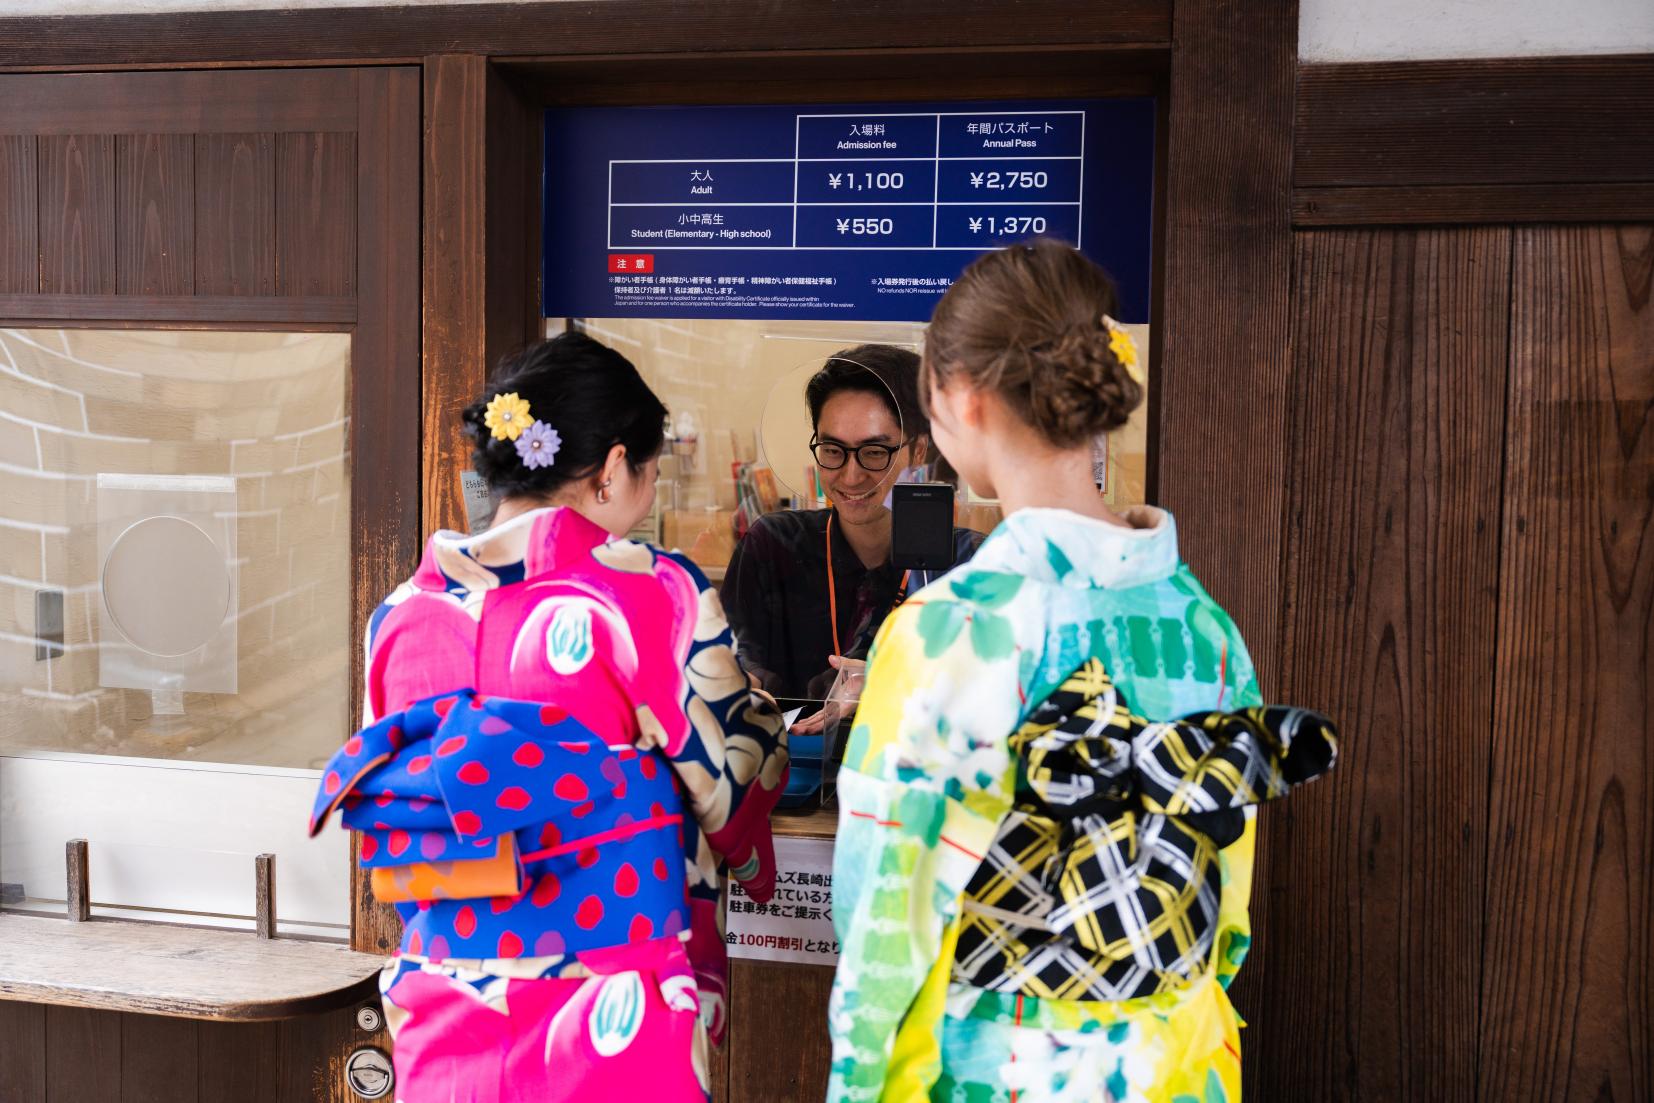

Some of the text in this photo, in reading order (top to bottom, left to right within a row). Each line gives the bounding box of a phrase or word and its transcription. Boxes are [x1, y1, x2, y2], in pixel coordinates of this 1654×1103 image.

[849, 123, 885, 136] 入場料
[966, 121, 1054, 135] 年間パスポート
[836, 140, 897, 150] Admission fee
[982, 138, 1037, 148] Annual Pass
[690, 169, 714, 182] 大人
[828, 172, 904, 191] ¥1,100
[970, 171, 1048, 191] ¥2,750
[690, 185, 713, 195] Adult
[677, 212, 724, 226] 小中高生
[836, 218, 894, 235] ¥550
[968, 217, 1047, 236] ¥1,370
[631, 229, 663, 238] Student
[664, 228, 714, 240] (Elementary
[720, 229, 740, 240] High
[740, 228, 772, 239] school)
[617, 258, 645, 269] 注意
